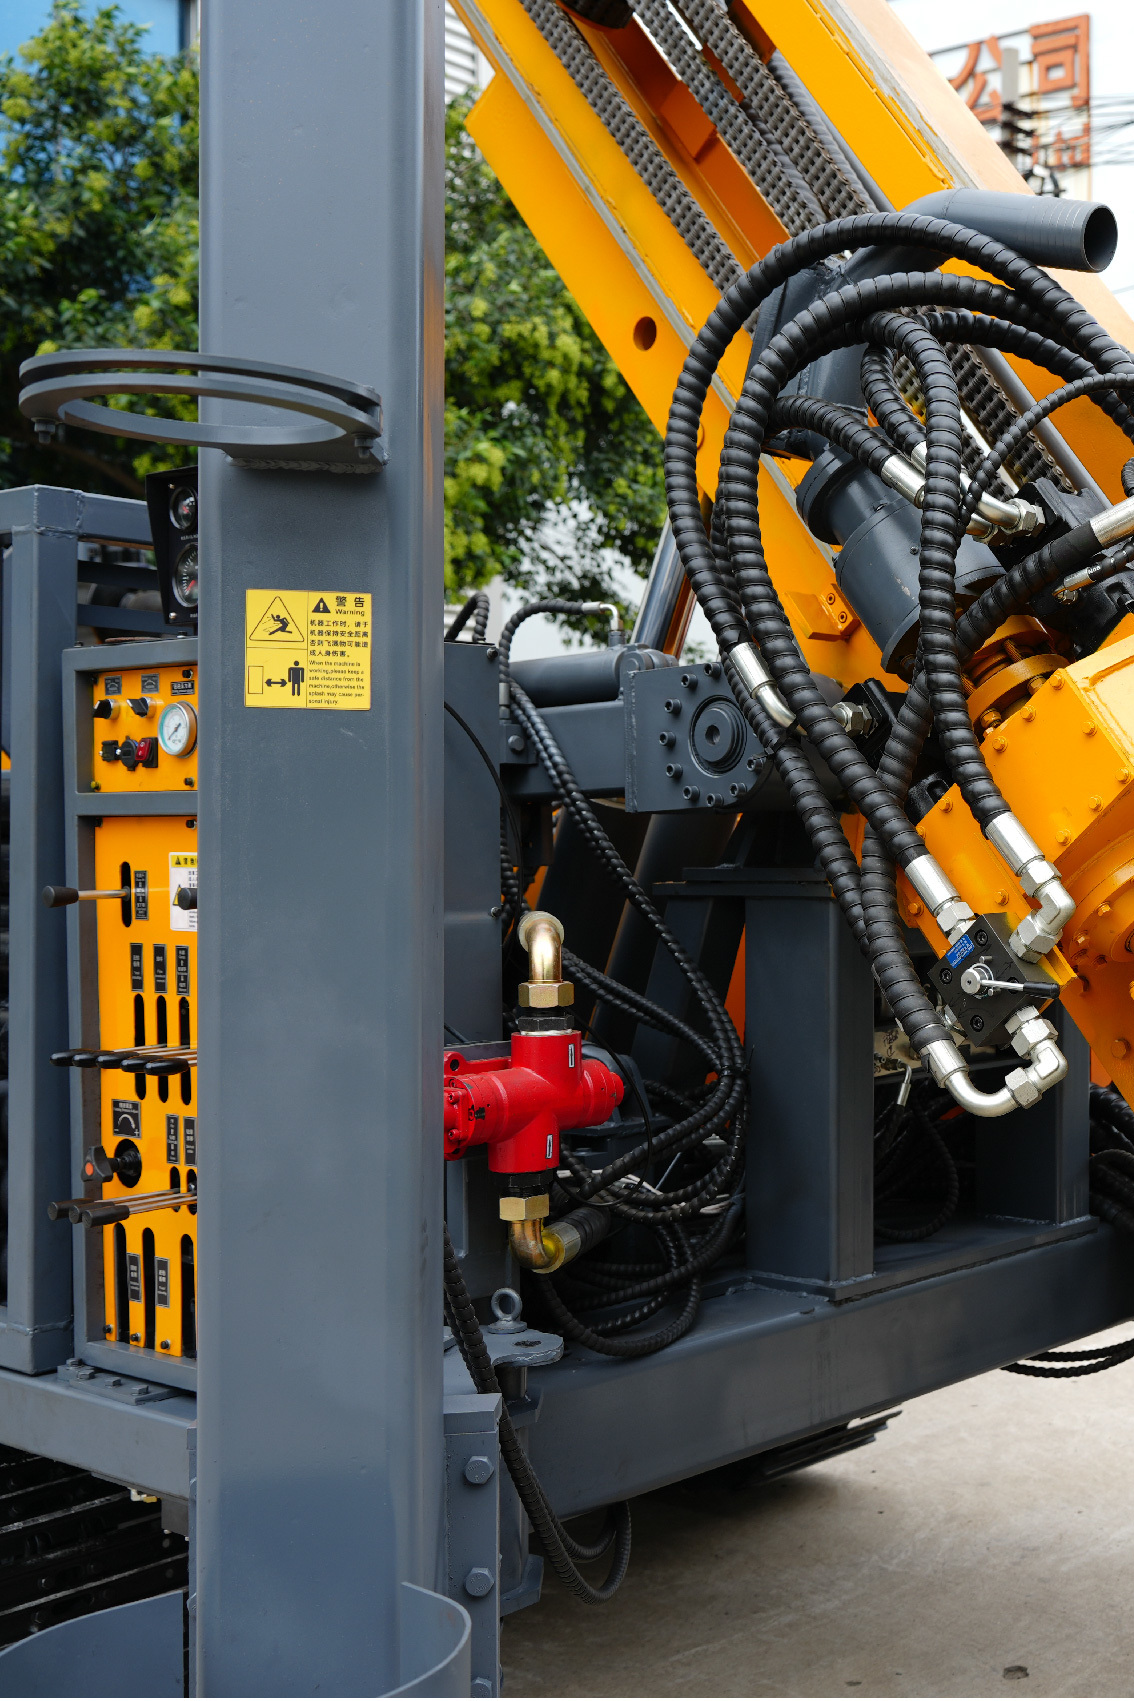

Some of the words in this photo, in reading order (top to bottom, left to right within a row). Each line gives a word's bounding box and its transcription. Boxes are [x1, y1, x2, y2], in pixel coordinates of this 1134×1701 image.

[947, 14, 1091, 122] 公司
[335, 595, 365, 608] 警告
[335, 608, 365, 617] Warning
[347, 668, 360, 676] keep
[309, 690, 326, 698] splash
